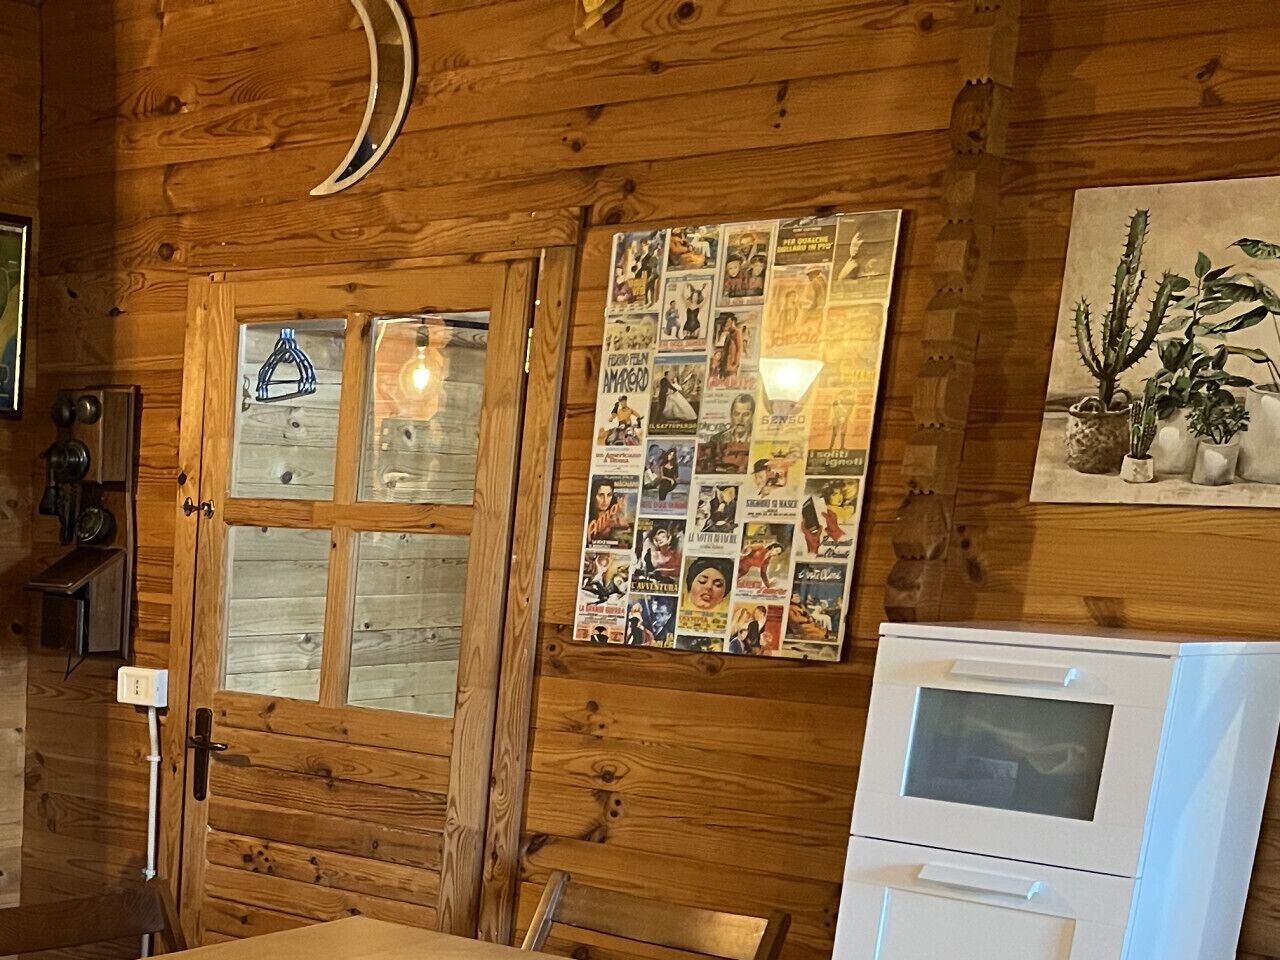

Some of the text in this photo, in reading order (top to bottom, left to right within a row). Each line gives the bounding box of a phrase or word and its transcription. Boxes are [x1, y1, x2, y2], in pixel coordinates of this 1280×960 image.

[603, 367, 649, 394] AMARCORD
[760, 416, 806, 425] SENSO
[825, 458, 862, 468] ignoti
